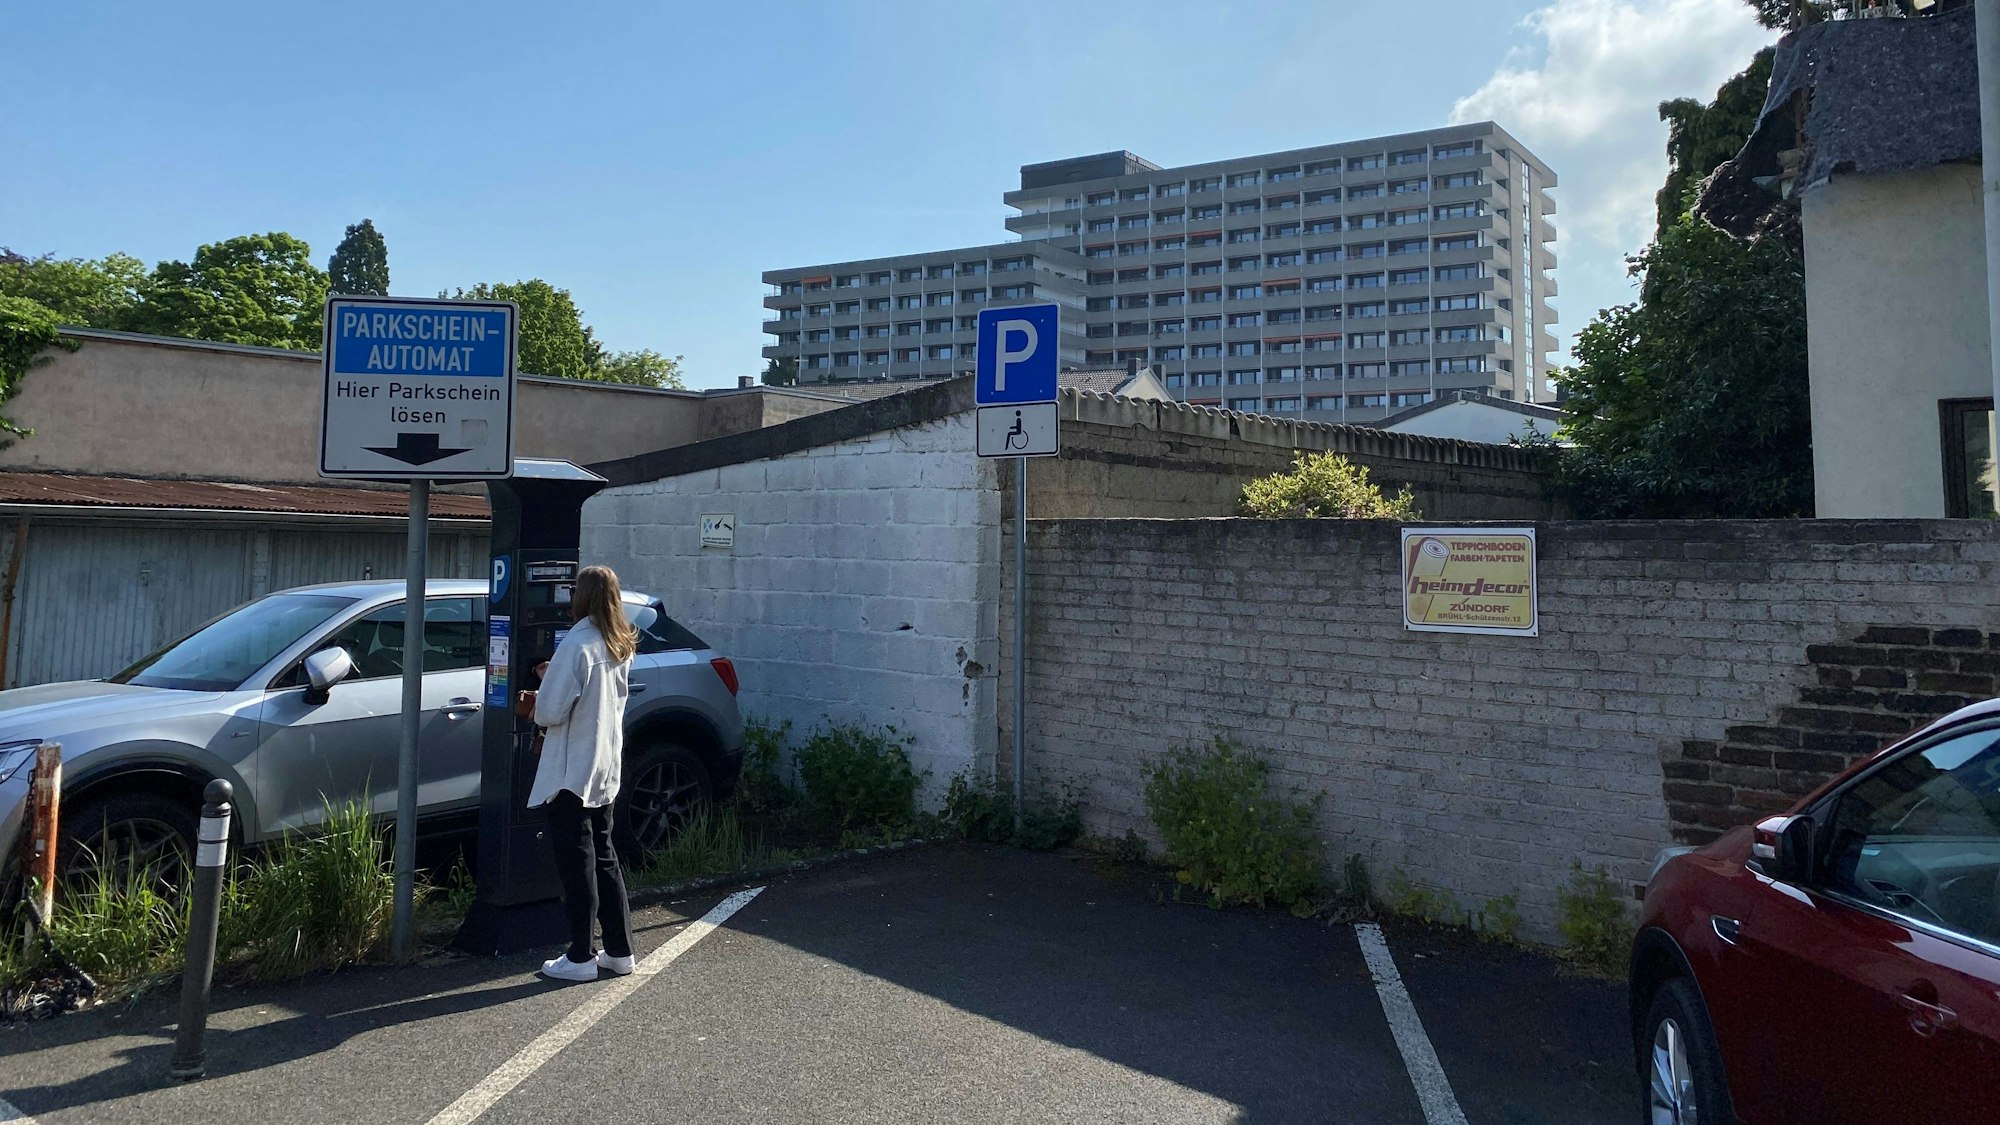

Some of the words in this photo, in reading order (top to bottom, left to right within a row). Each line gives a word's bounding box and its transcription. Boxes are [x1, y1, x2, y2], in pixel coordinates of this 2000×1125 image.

[343, 313, 500, 342] PARKSCHEIN-
[367, 345, 474, 372] AUTOMAT
[994, 319, 1039, 392] P
[337, 381, 380, 398] Hier
[389, 382, 500, 401] Parkschein
[391, 406, 446, 424] lösen
[1450, 541, 1526, 552] TEPPICHBODEN
[493, 559, 506, 594] P
[1410, 576, 1530, 596] heimdecor
